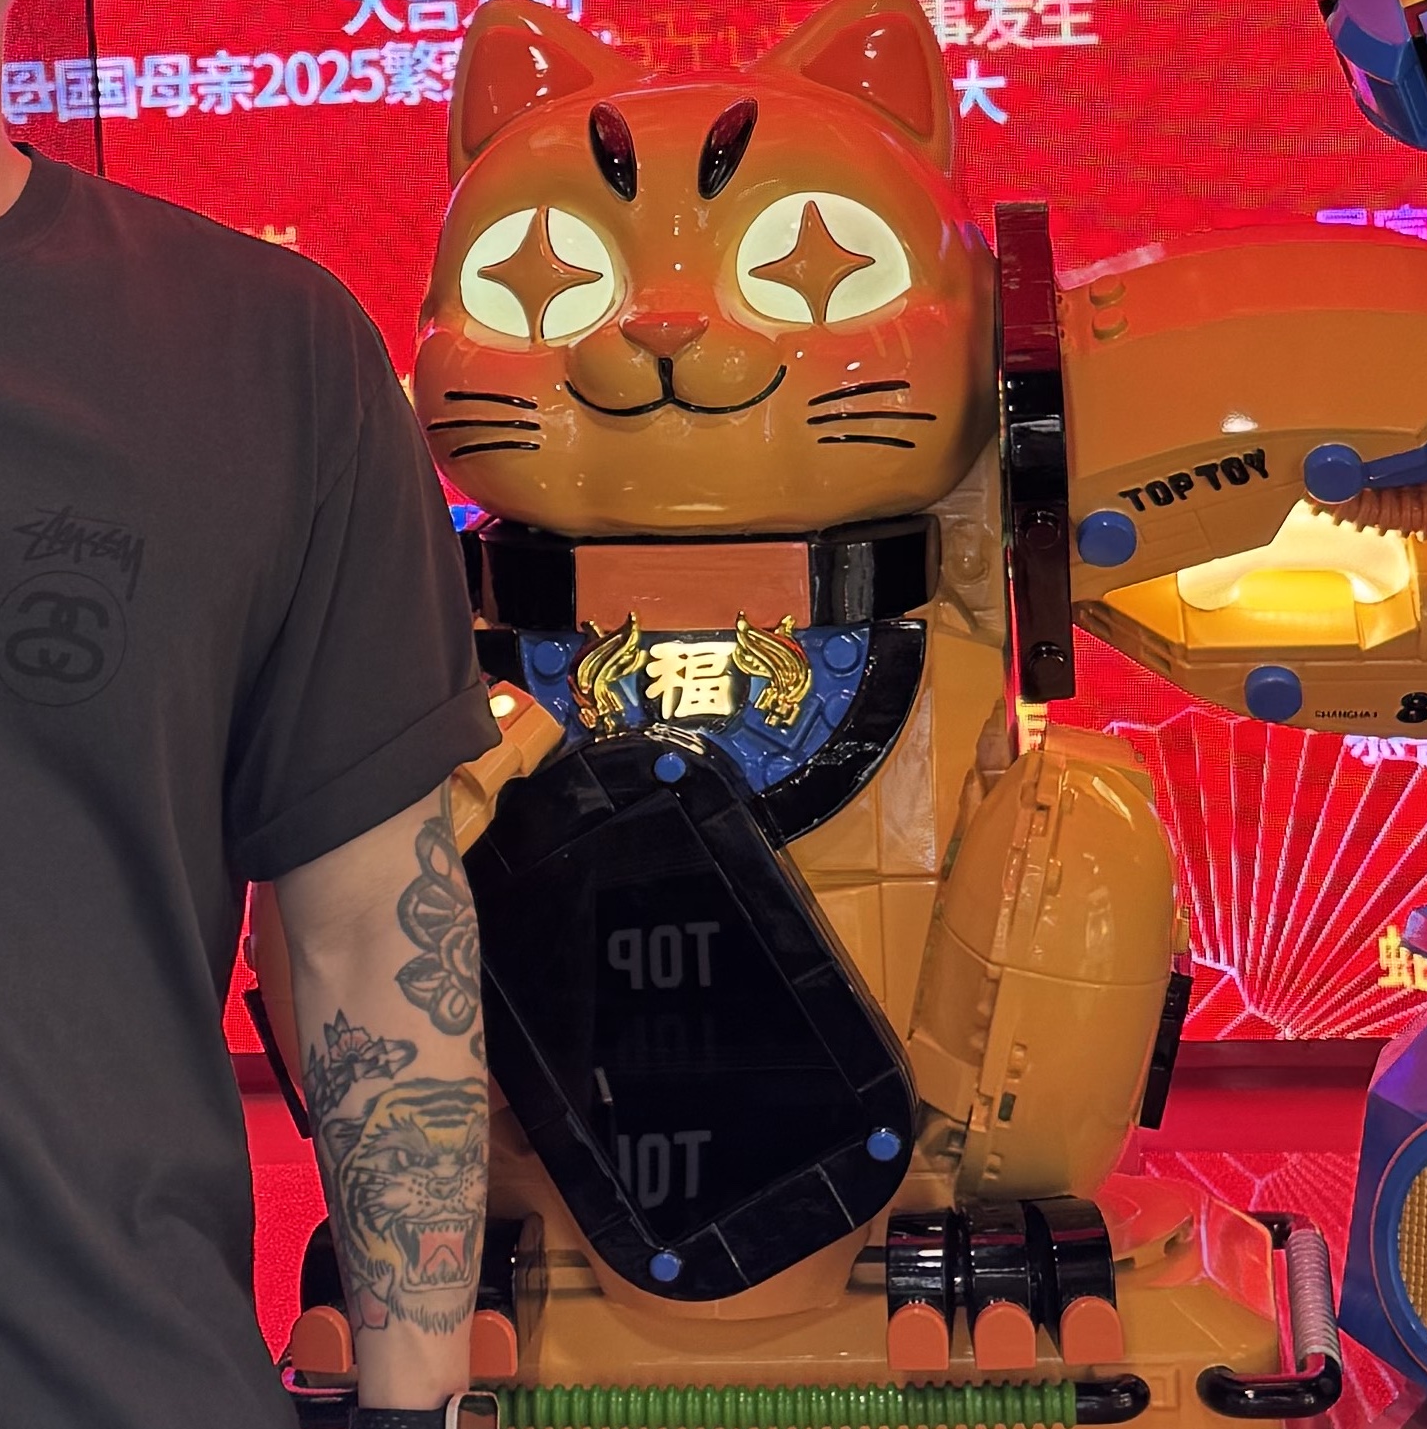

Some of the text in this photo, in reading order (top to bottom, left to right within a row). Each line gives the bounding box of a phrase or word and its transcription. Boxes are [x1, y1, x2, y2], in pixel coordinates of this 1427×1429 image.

[1118, 448, 1269, 512] TOP TOY
[645, 640, 736, 720] 福
